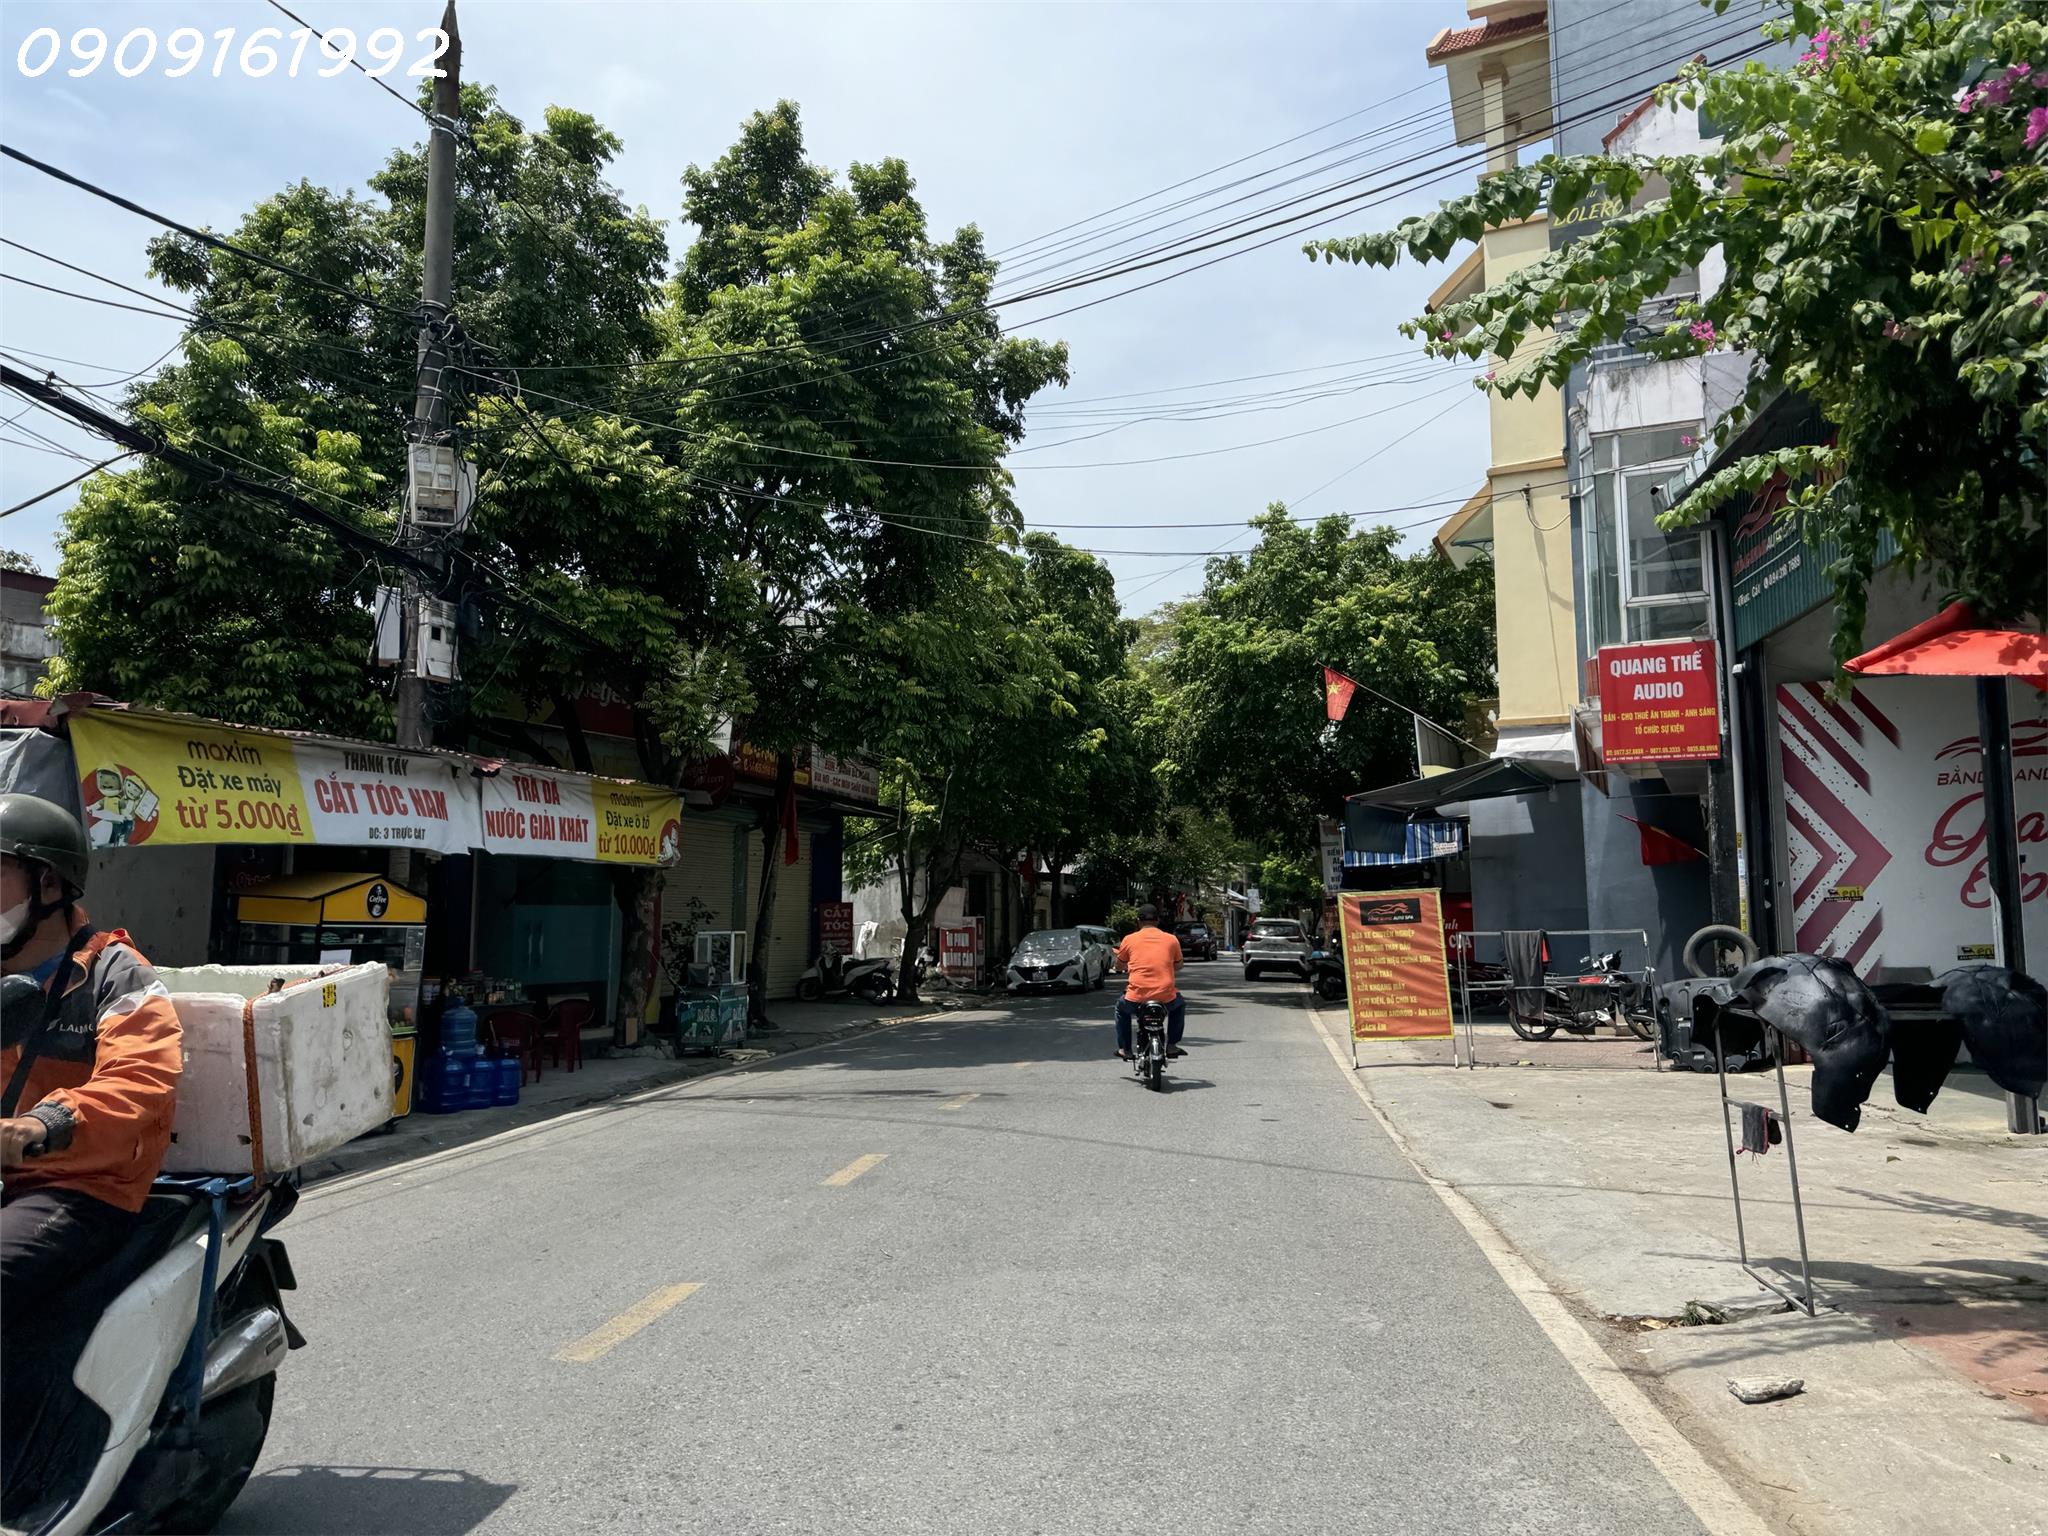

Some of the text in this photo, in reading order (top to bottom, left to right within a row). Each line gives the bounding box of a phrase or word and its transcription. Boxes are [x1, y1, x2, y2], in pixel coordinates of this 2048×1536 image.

[1610, 648, 1703, 678] QUANG THẾ
[1633, 681, 1684, 700] AUDIO
[1621, 712, 1633, 721] CHO
[1660, 709, 1680, 719] THANH
[187, 740, 262, 765] maxim
[343, 751, 385, 774] THANH
[177, 765, 281, 798] Đặt xe máy
[512, 774, 541, 803] TRÀ
[314, 771, 449, 821] CẮT TÓC NAM
[610, 792, 644, 809] maxim
[176, 797, 208, 828] từ
[606, 810, 622, 830] Đặt
[623, 816, 634, 828] xe
[383, 827, 389, 840] 3
[485, 808, 589, 843] NƯỚC GIẢI KHÁT
[598, 832, 613, 853] từ
[368, 894, 387, 904] Coffee
[823, 918, 850, 930] TÓC
